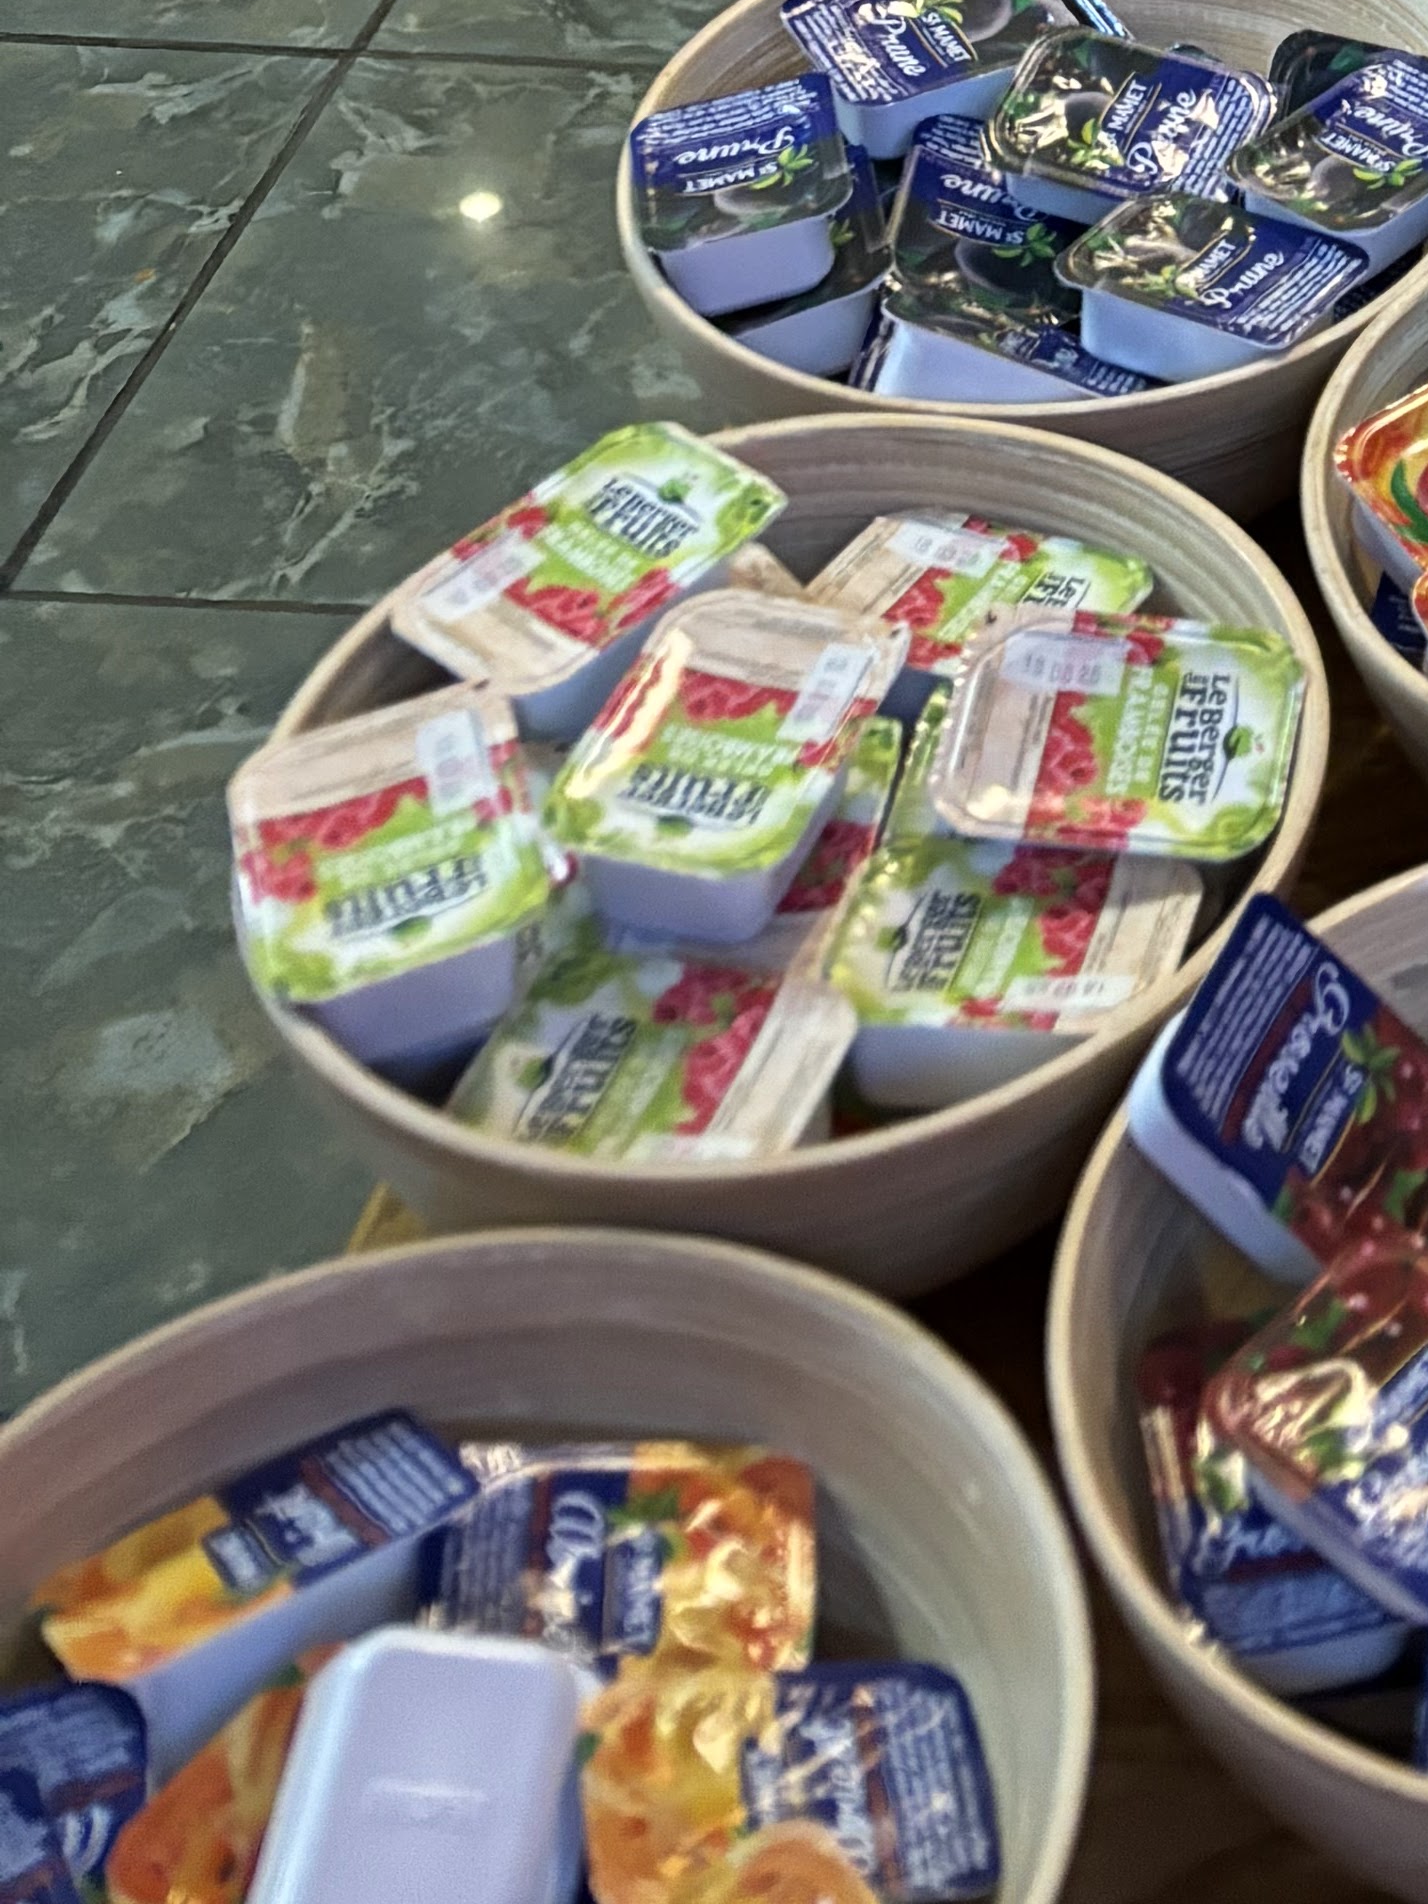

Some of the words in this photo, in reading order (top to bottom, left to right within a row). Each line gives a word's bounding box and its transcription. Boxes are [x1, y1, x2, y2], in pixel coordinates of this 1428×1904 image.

[870, 14, 926, 76] Prune
[932, 21, 969, 64] MAMET
[673, 125, 795, 166] Prune
[684, 165, 761, 191] MAMET
[938, 210, 1002, 244] MAMET
[1202, 251, 1286, 309] Prune
[1159, 686, 1207, 802] Fruits
